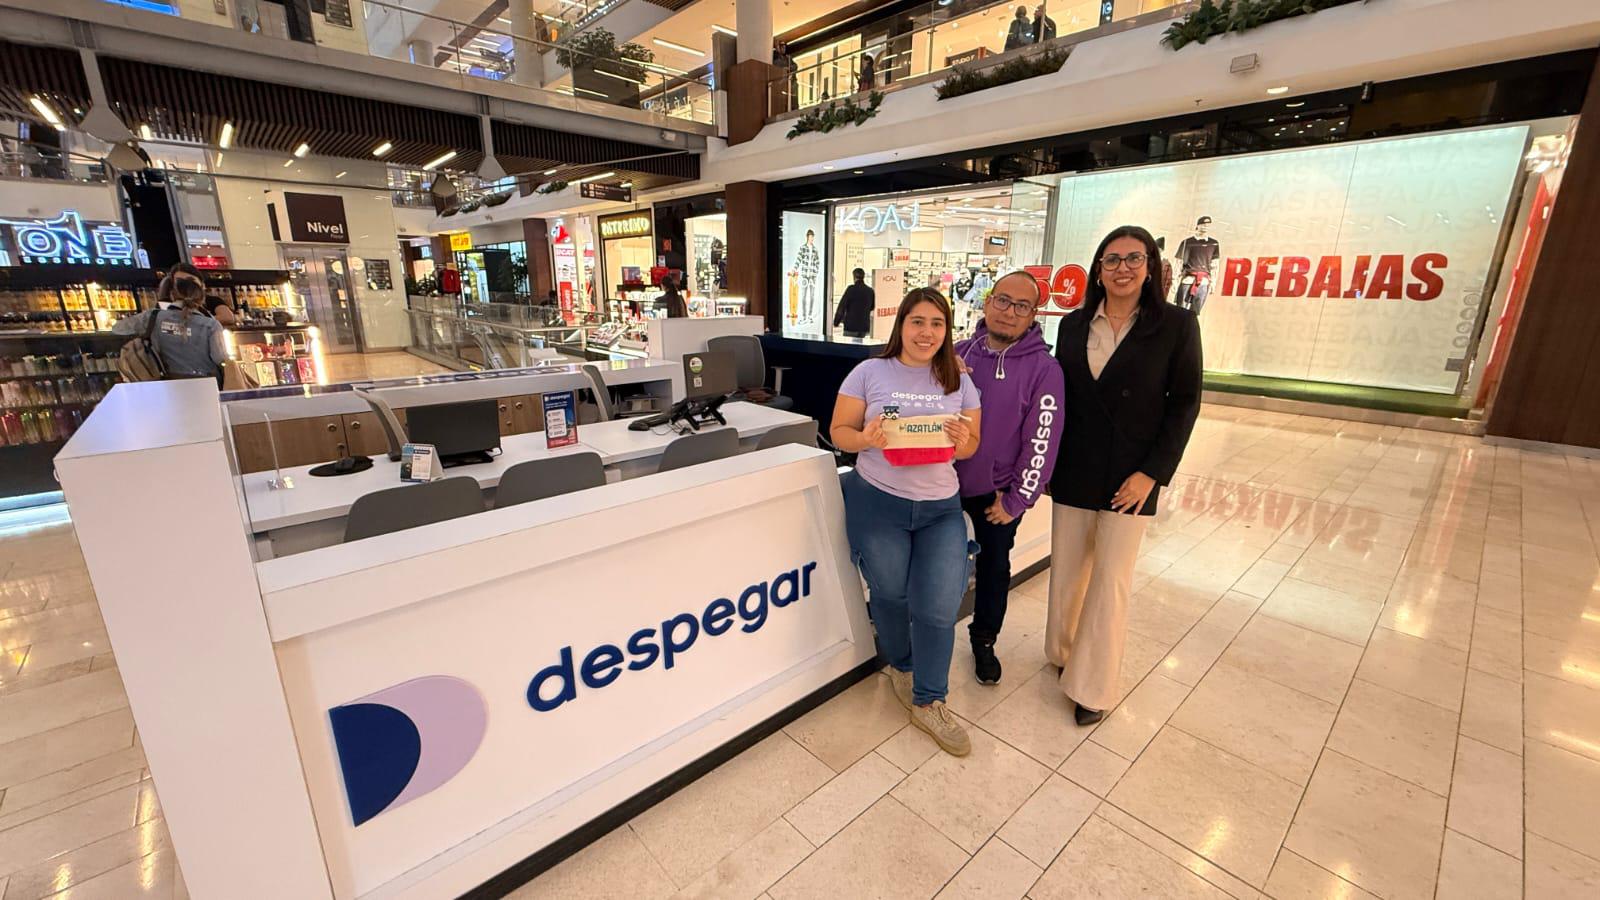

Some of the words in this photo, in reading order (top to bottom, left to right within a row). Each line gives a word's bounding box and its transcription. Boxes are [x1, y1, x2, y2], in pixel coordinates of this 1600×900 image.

[17, 210, 133, 259] ONE
[306, 222, 344, 234] Nivel
[1221, 253, 1449, 302] REBAJAS
[891, 391, 942, 401] despegar
[1019, 394, 1058, 499] despegar
[526, 561, 817, 712] despegar
